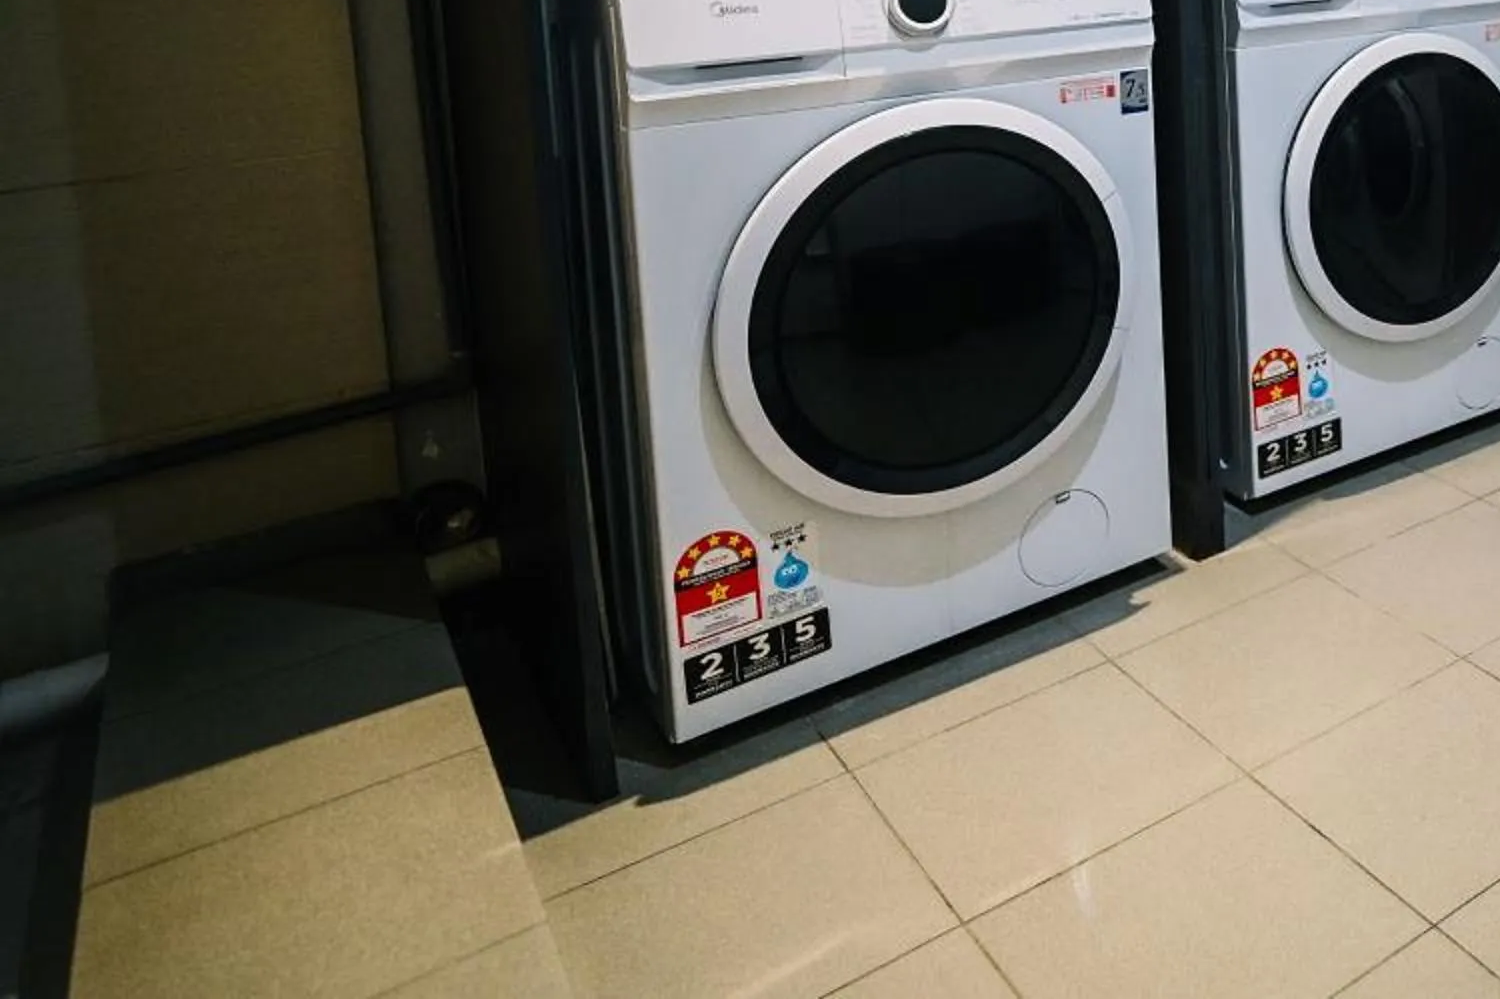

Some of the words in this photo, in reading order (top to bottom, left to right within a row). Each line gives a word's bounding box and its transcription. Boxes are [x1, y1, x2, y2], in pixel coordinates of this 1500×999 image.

[709, 1, 760, 18] Midea
[1266, 443, 1281, 462] 2
[1294, 432, 1307, 452] 3
[1321, 423, 1333, 442] 5
[700, 652, 725, 680] 2
[747, 632, 771, 660] 3
[795, 615, 817, 642] 5
